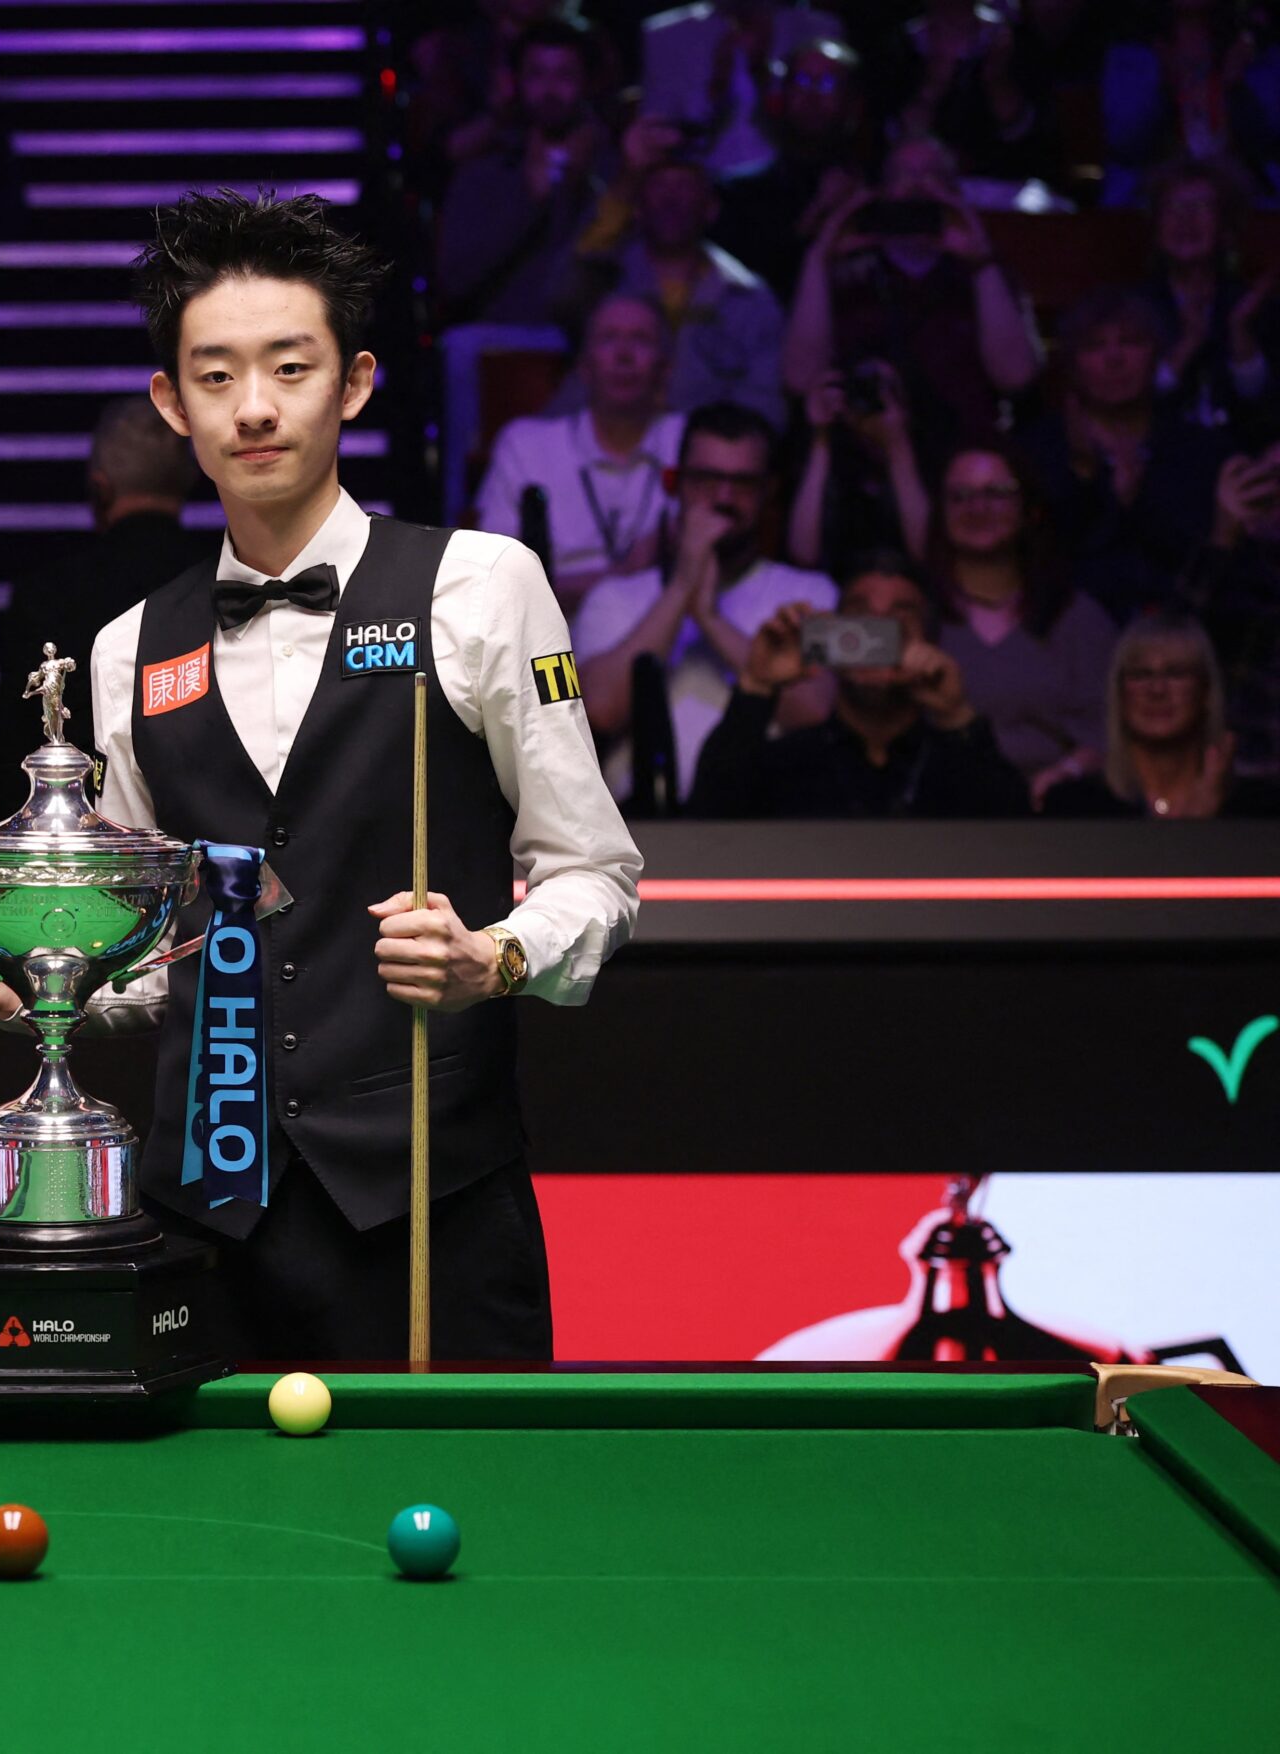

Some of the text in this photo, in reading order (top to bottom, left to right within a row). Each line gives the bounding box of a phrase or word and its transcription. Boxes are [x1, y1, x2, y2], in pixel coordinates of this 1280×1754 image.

[346, 622, 416, 646] HALO
[346, 642, 415, 671] CRM
[208, 996, 257, 1173] HALO
[33, 1320, 75, 1332] HALO
[152, 1305, 189, 1336] HALO
[33, 1333, 111, 1343] WORLD CHAMPIONSHIP
